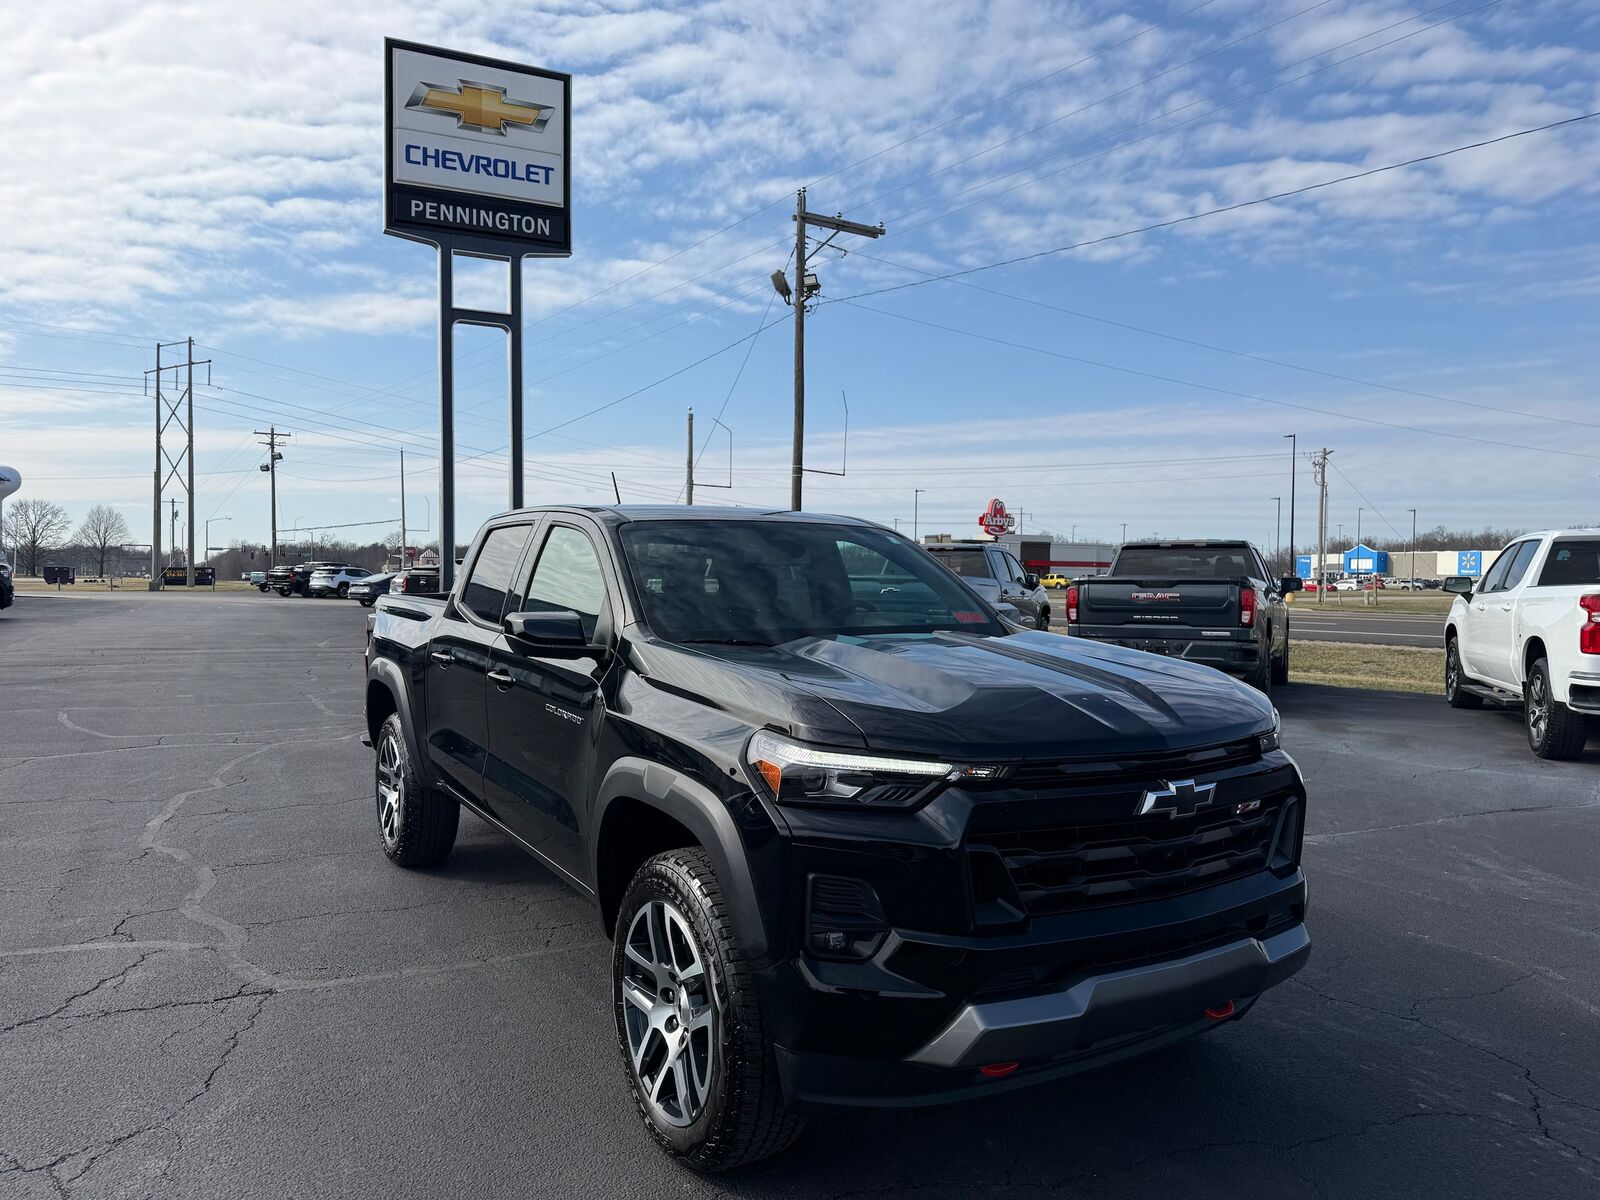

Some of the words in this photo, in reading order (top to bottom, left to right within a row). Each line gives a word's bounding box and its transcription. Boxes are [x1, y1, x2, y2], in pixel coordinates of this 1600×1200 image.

[405, 144, 554, 185] CHEVROLET
[411, 199, 550, 236] PENNINGTON
[545, 703, 582, 725] COLORADO
